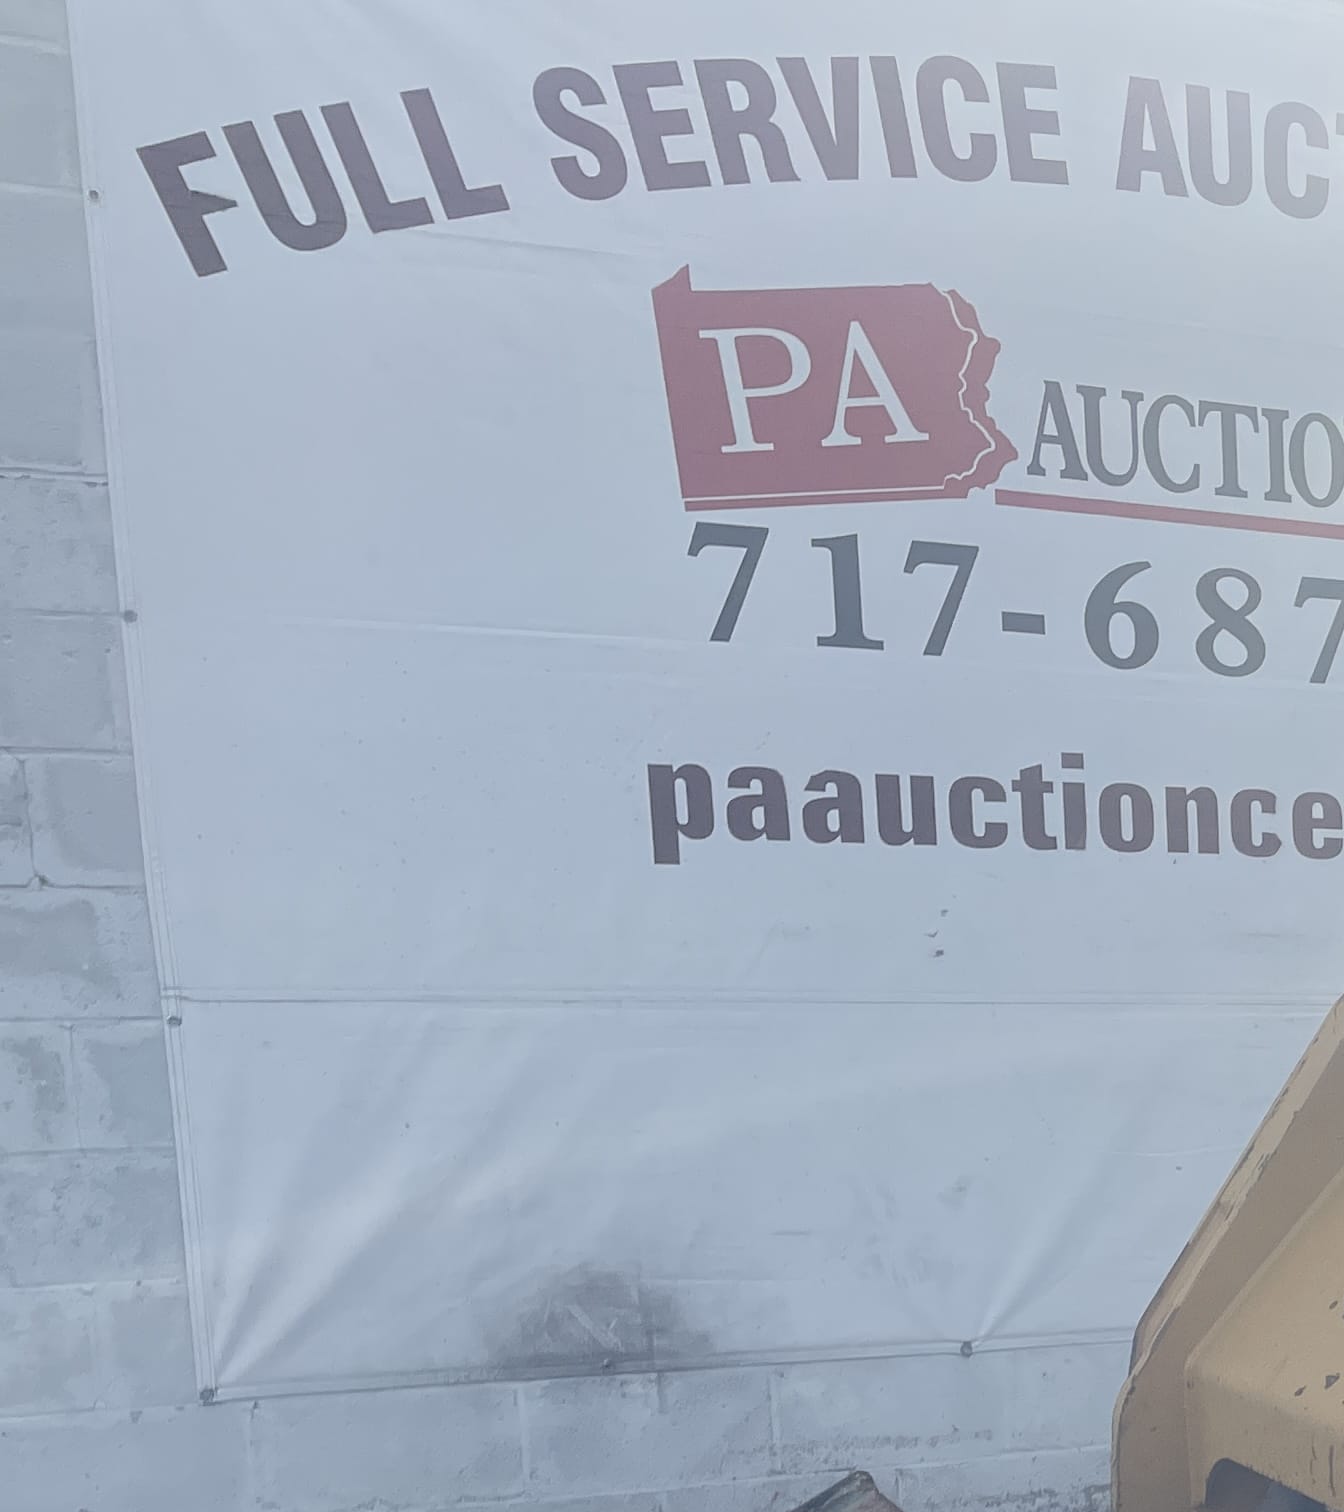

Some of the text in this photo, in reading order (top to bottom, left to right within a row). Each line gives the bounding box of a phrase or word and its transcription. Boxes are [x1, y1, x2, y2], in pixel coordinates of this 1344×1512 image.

[136, 88, 510, 277] FULL
[532, 55, 1069, 201] SERVICE
[699, 320, 929, 453] PA
